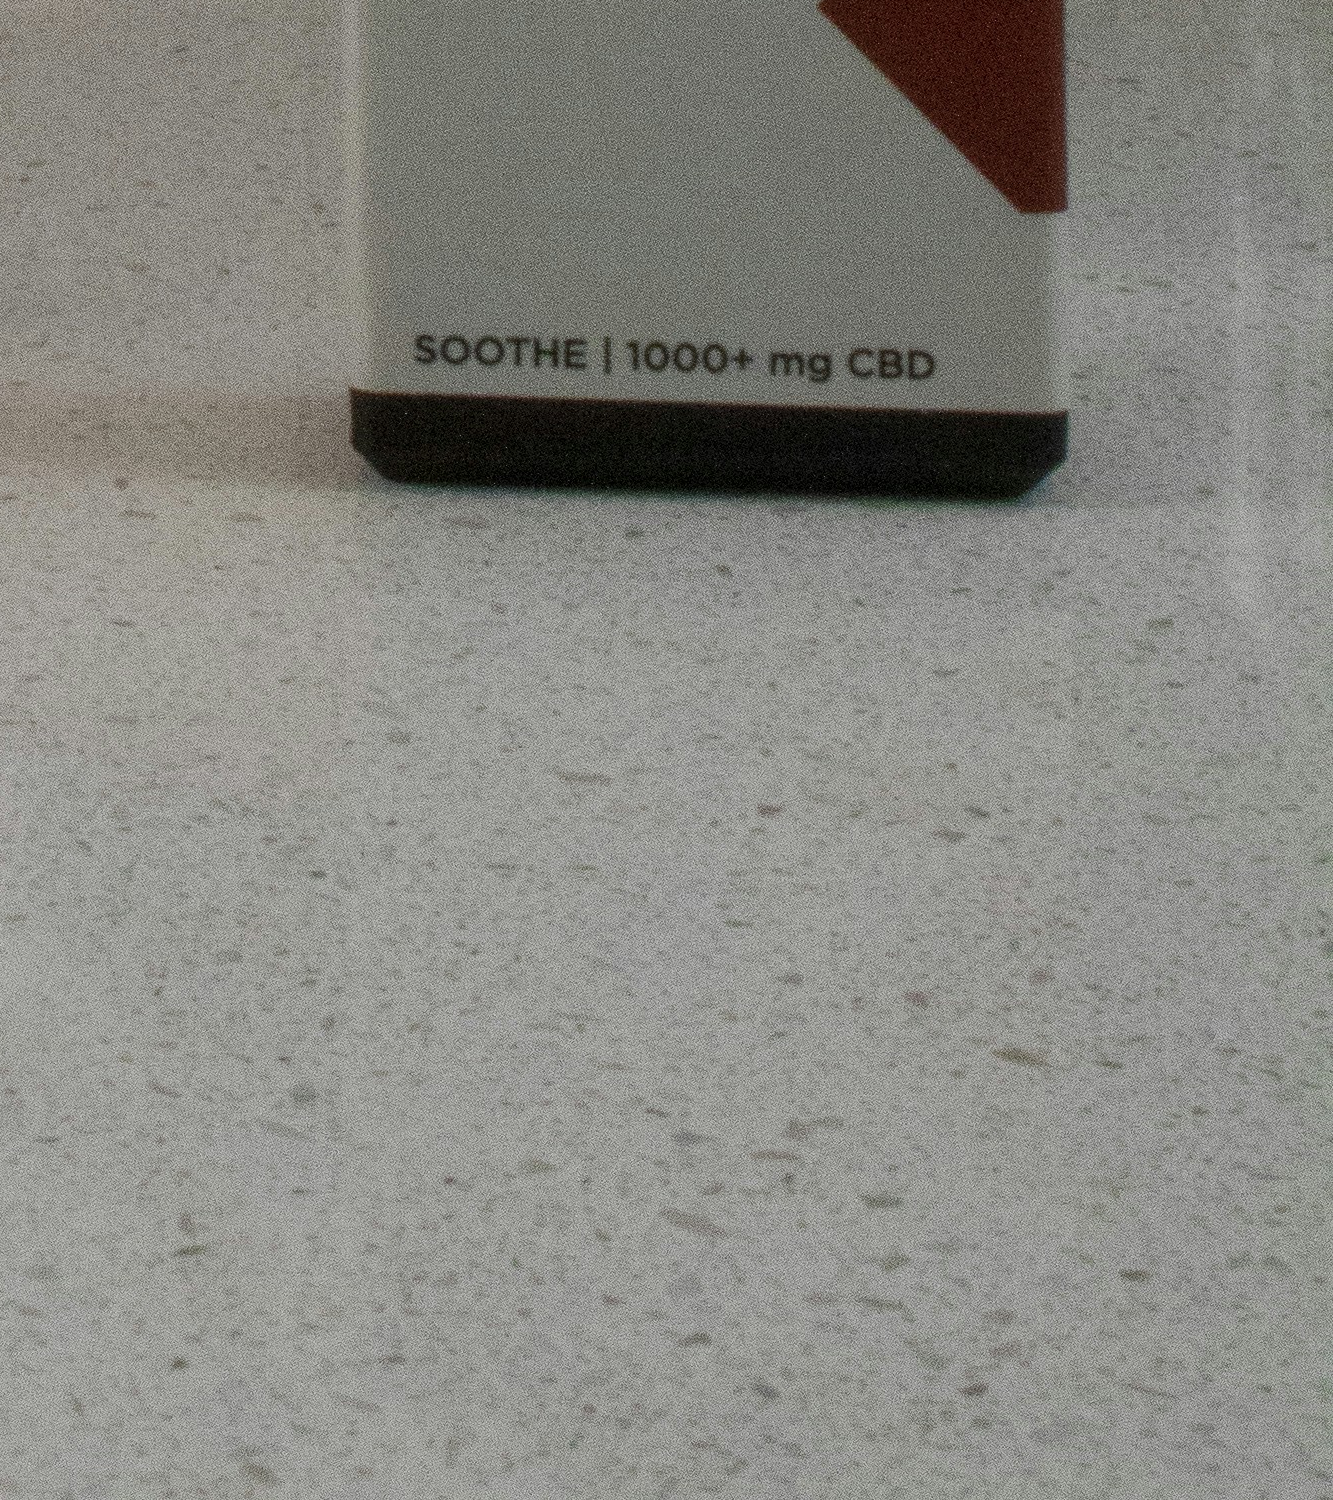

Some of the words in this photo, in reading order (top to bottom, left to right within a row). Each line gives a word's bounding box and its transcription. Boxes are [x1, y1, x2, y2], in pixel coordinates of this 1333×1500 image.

[414, 334, 588, 370] SOOTHE
[626, 338, 753, 375] 1000+
[769, 347, 833, 383] mg
[846, 346, 934, 381] CBD
